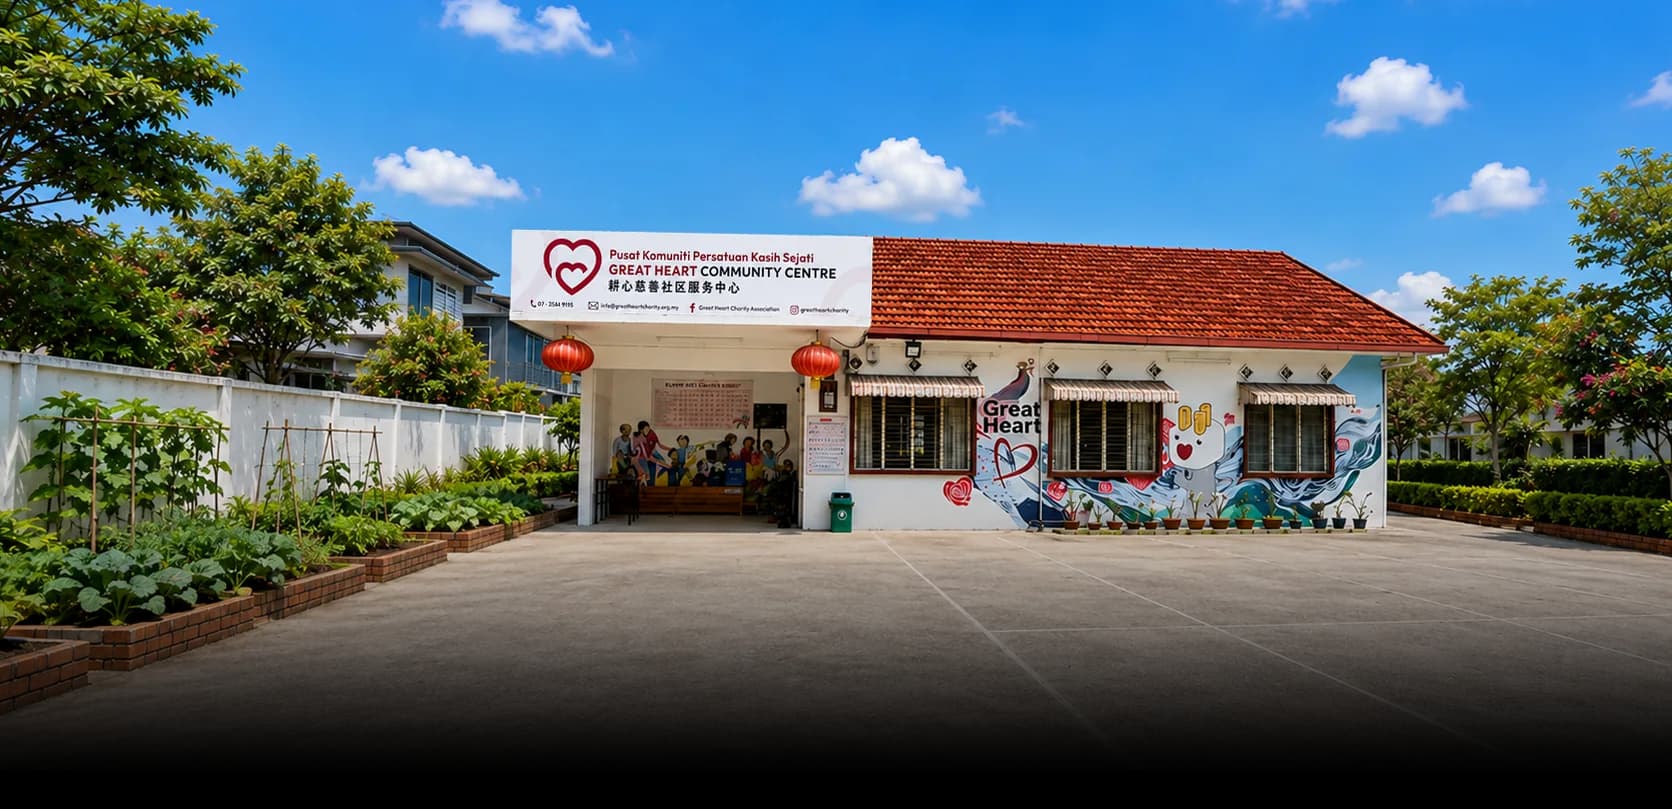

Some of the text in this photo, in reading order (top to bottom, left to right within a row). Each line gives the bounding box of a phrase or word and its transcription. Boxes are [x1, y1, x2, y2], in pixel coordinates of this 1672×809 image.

[610, 249, 814, 265] Pusat Komuniti Persatuan Kasih Sejati
[609, 264, 837, 279] GREAT HEART COMMUNITY CENTRE
[608, 280, 740, 294] 耕心慈善社区服务中心
[731, 305, 749, 313] Charity
[983, 400, 1041, 417] Great
[983, 418, 1041, 434] Heart
